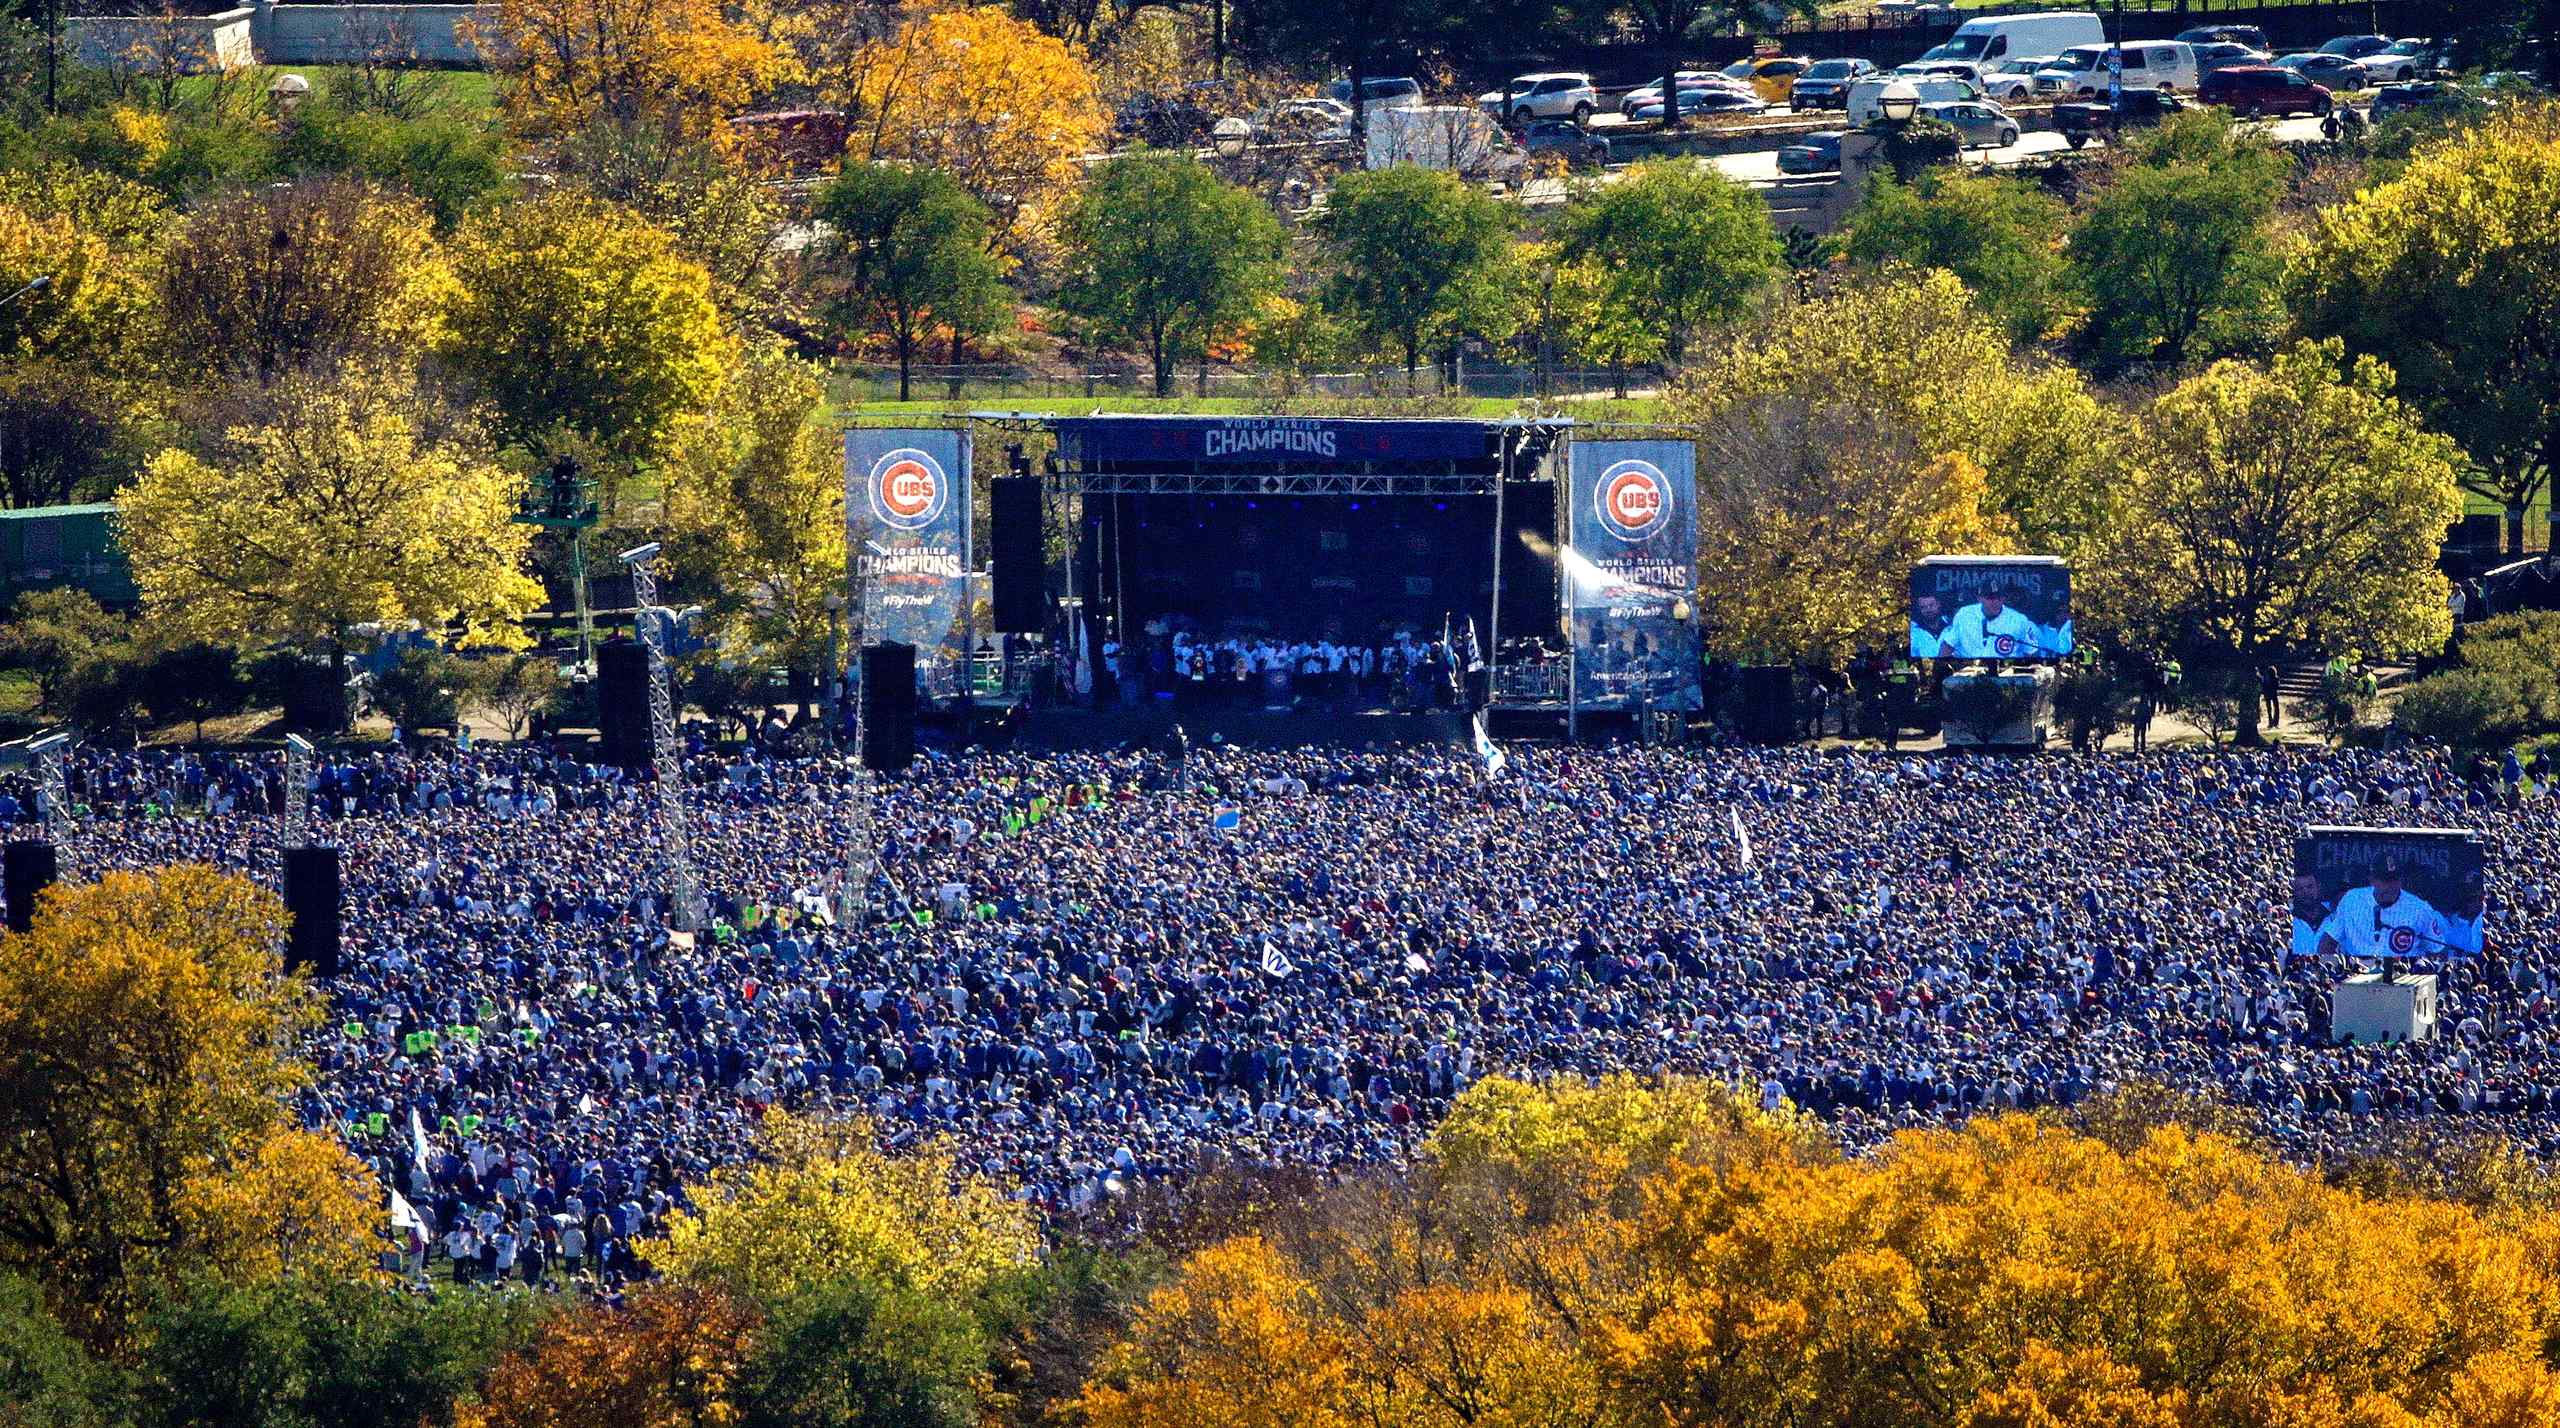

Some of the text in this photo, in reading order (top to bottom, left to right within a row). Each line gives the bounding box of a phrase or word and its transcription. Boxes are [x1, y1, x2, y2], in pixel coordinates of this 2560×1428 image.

[1223, 419, 1321, 430] WORLD SERIES
[1206, 430, 1337, 457] CHAMPIONS
[882, 463, 934, 515] CUBS
[1608, 474, 1660, 527] CUBS
[857, 555, 962, 578] CHAMPIONS
[1597, 559, 1632, 567] WORLD
[882, 594, 935, 609] #FlyTheW
